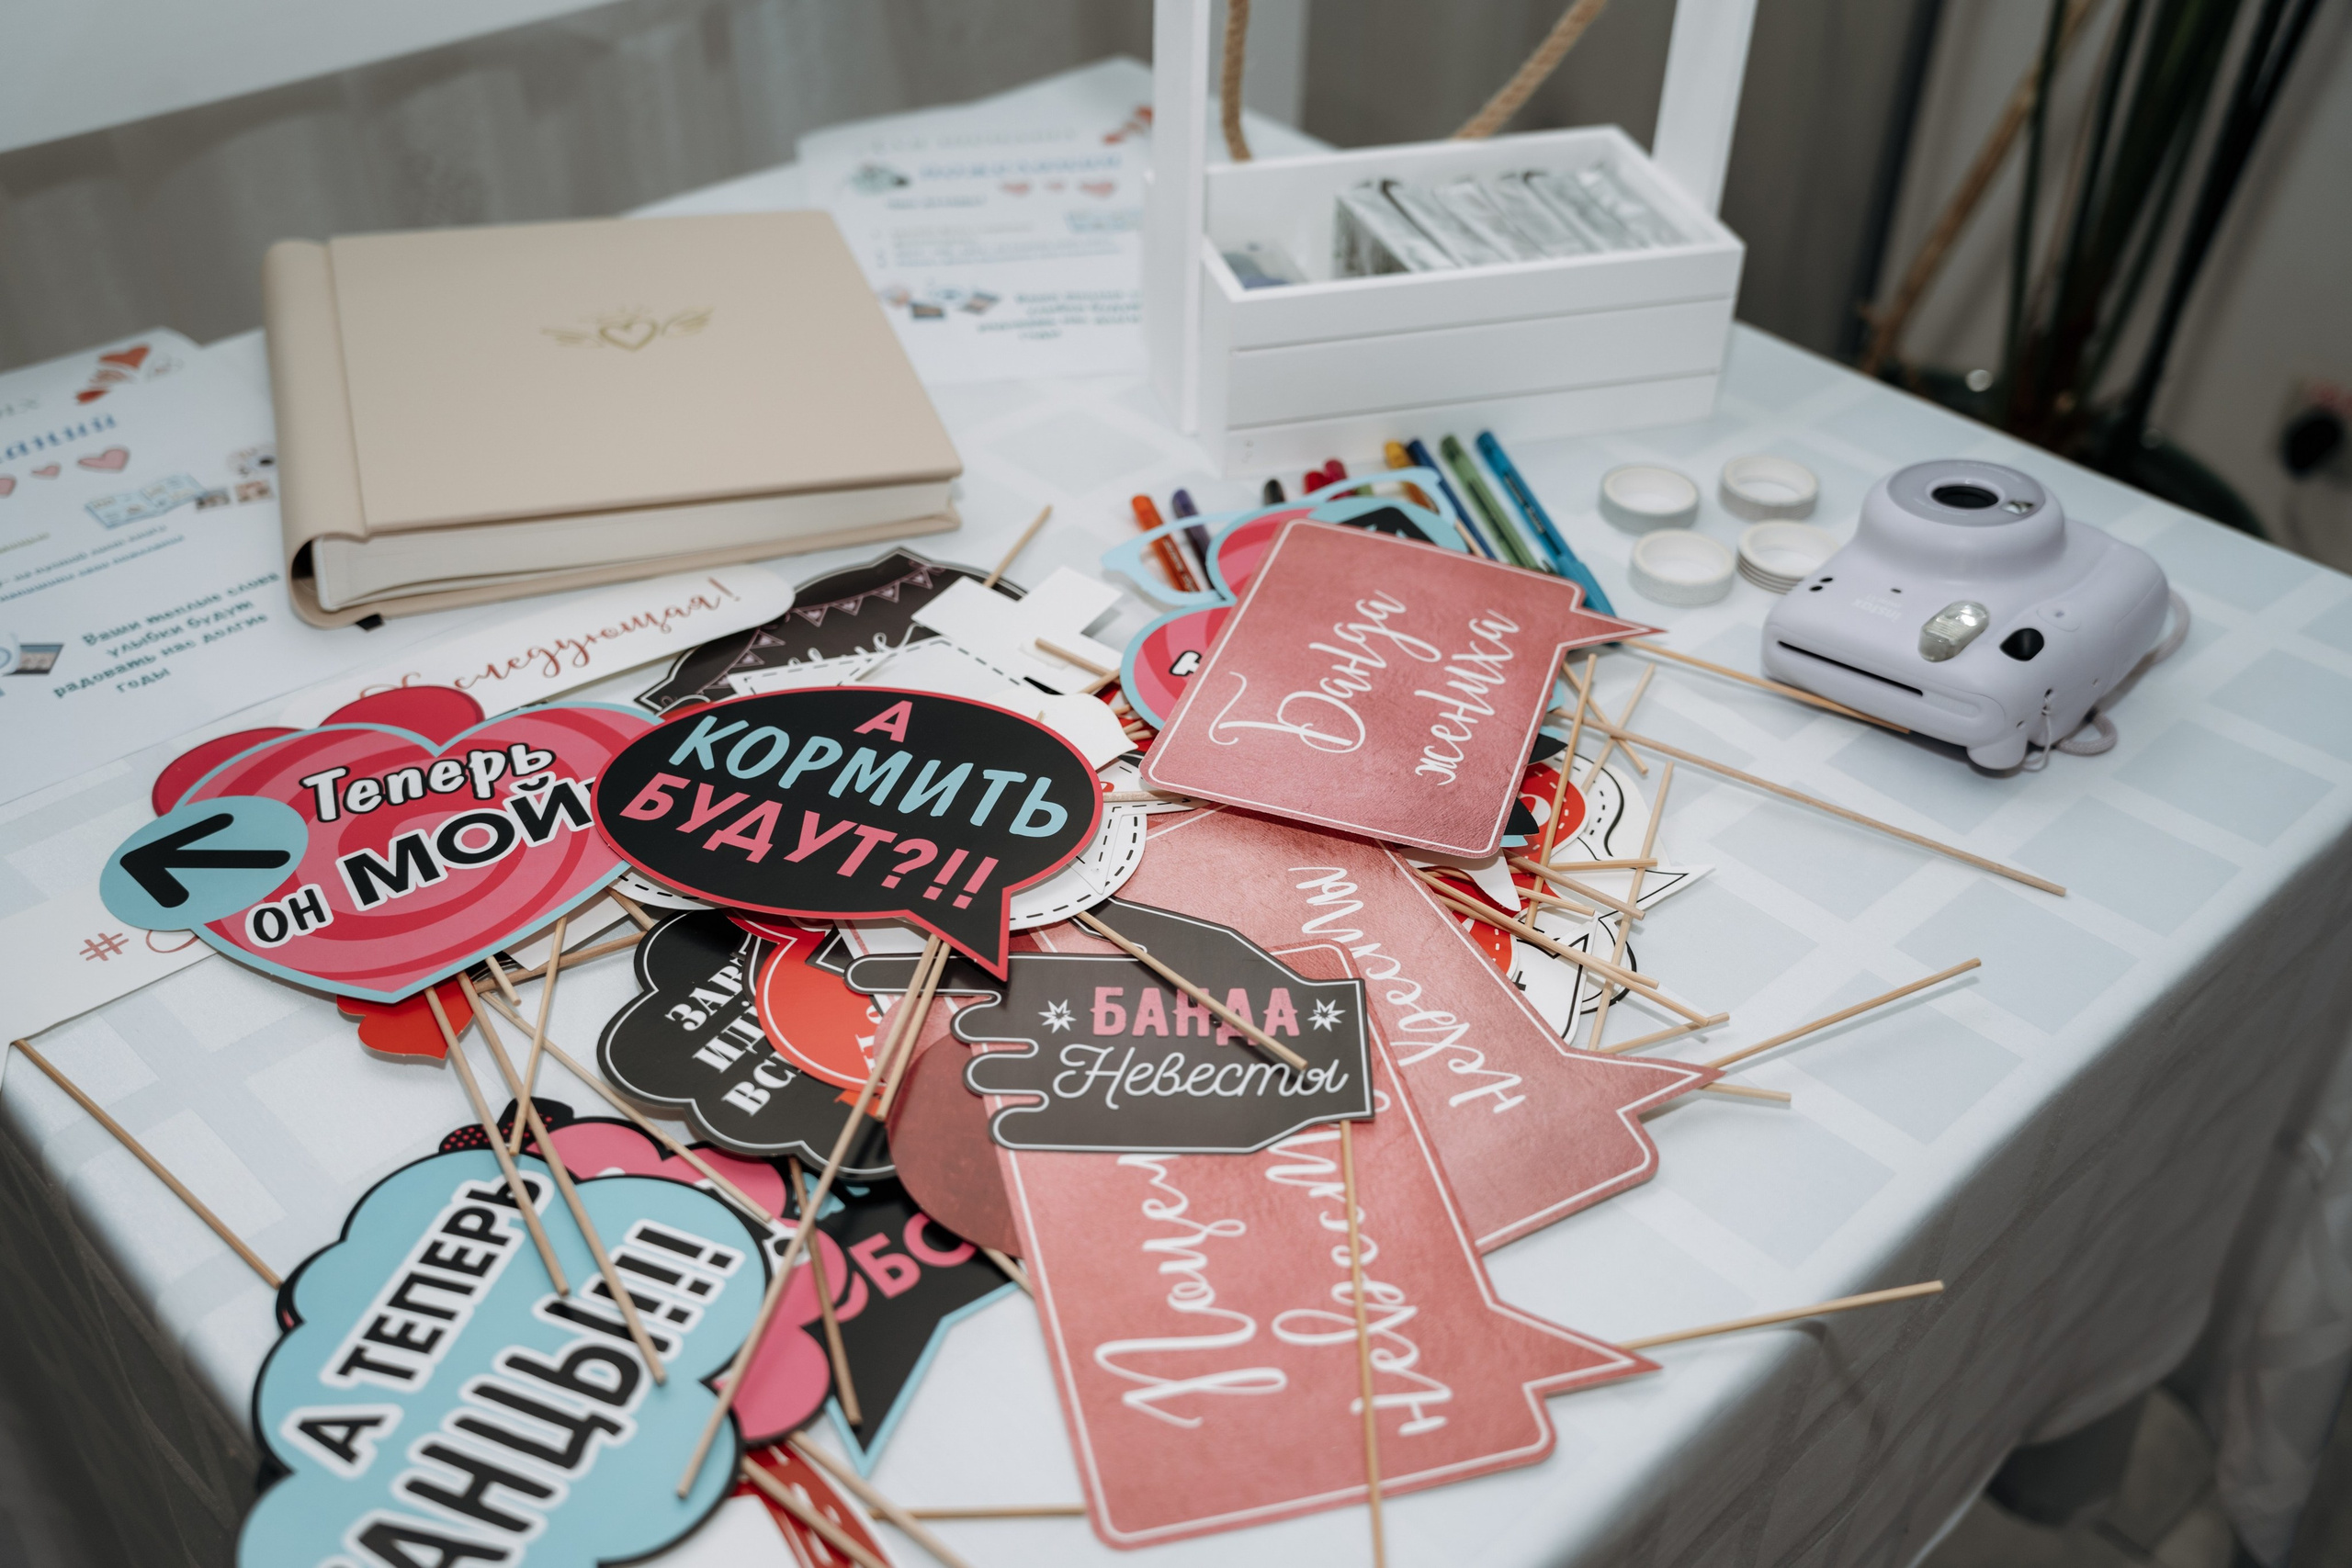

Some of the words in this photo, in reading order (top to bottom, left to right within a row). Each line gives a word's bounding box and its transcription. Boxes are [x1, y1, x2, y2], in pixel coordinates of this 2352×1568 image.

[854, 700, 913, 742] А
[299, 743, 557, 823] Теперь
[669, 715, 1069, 838] КОРМИТЬ
[618, 772, 1000, 909] БУДУТ?!!
[1090, 987, 1301, 1046] БАНДА
[1053, 1043, 1349, 1110] Невесты
[331, 1176, 548, 1385] ТЕПЕРЬ
[349, 1224, 738, 1568] АНЦЫ!!!
[288, 1409, 396, 1472] А
